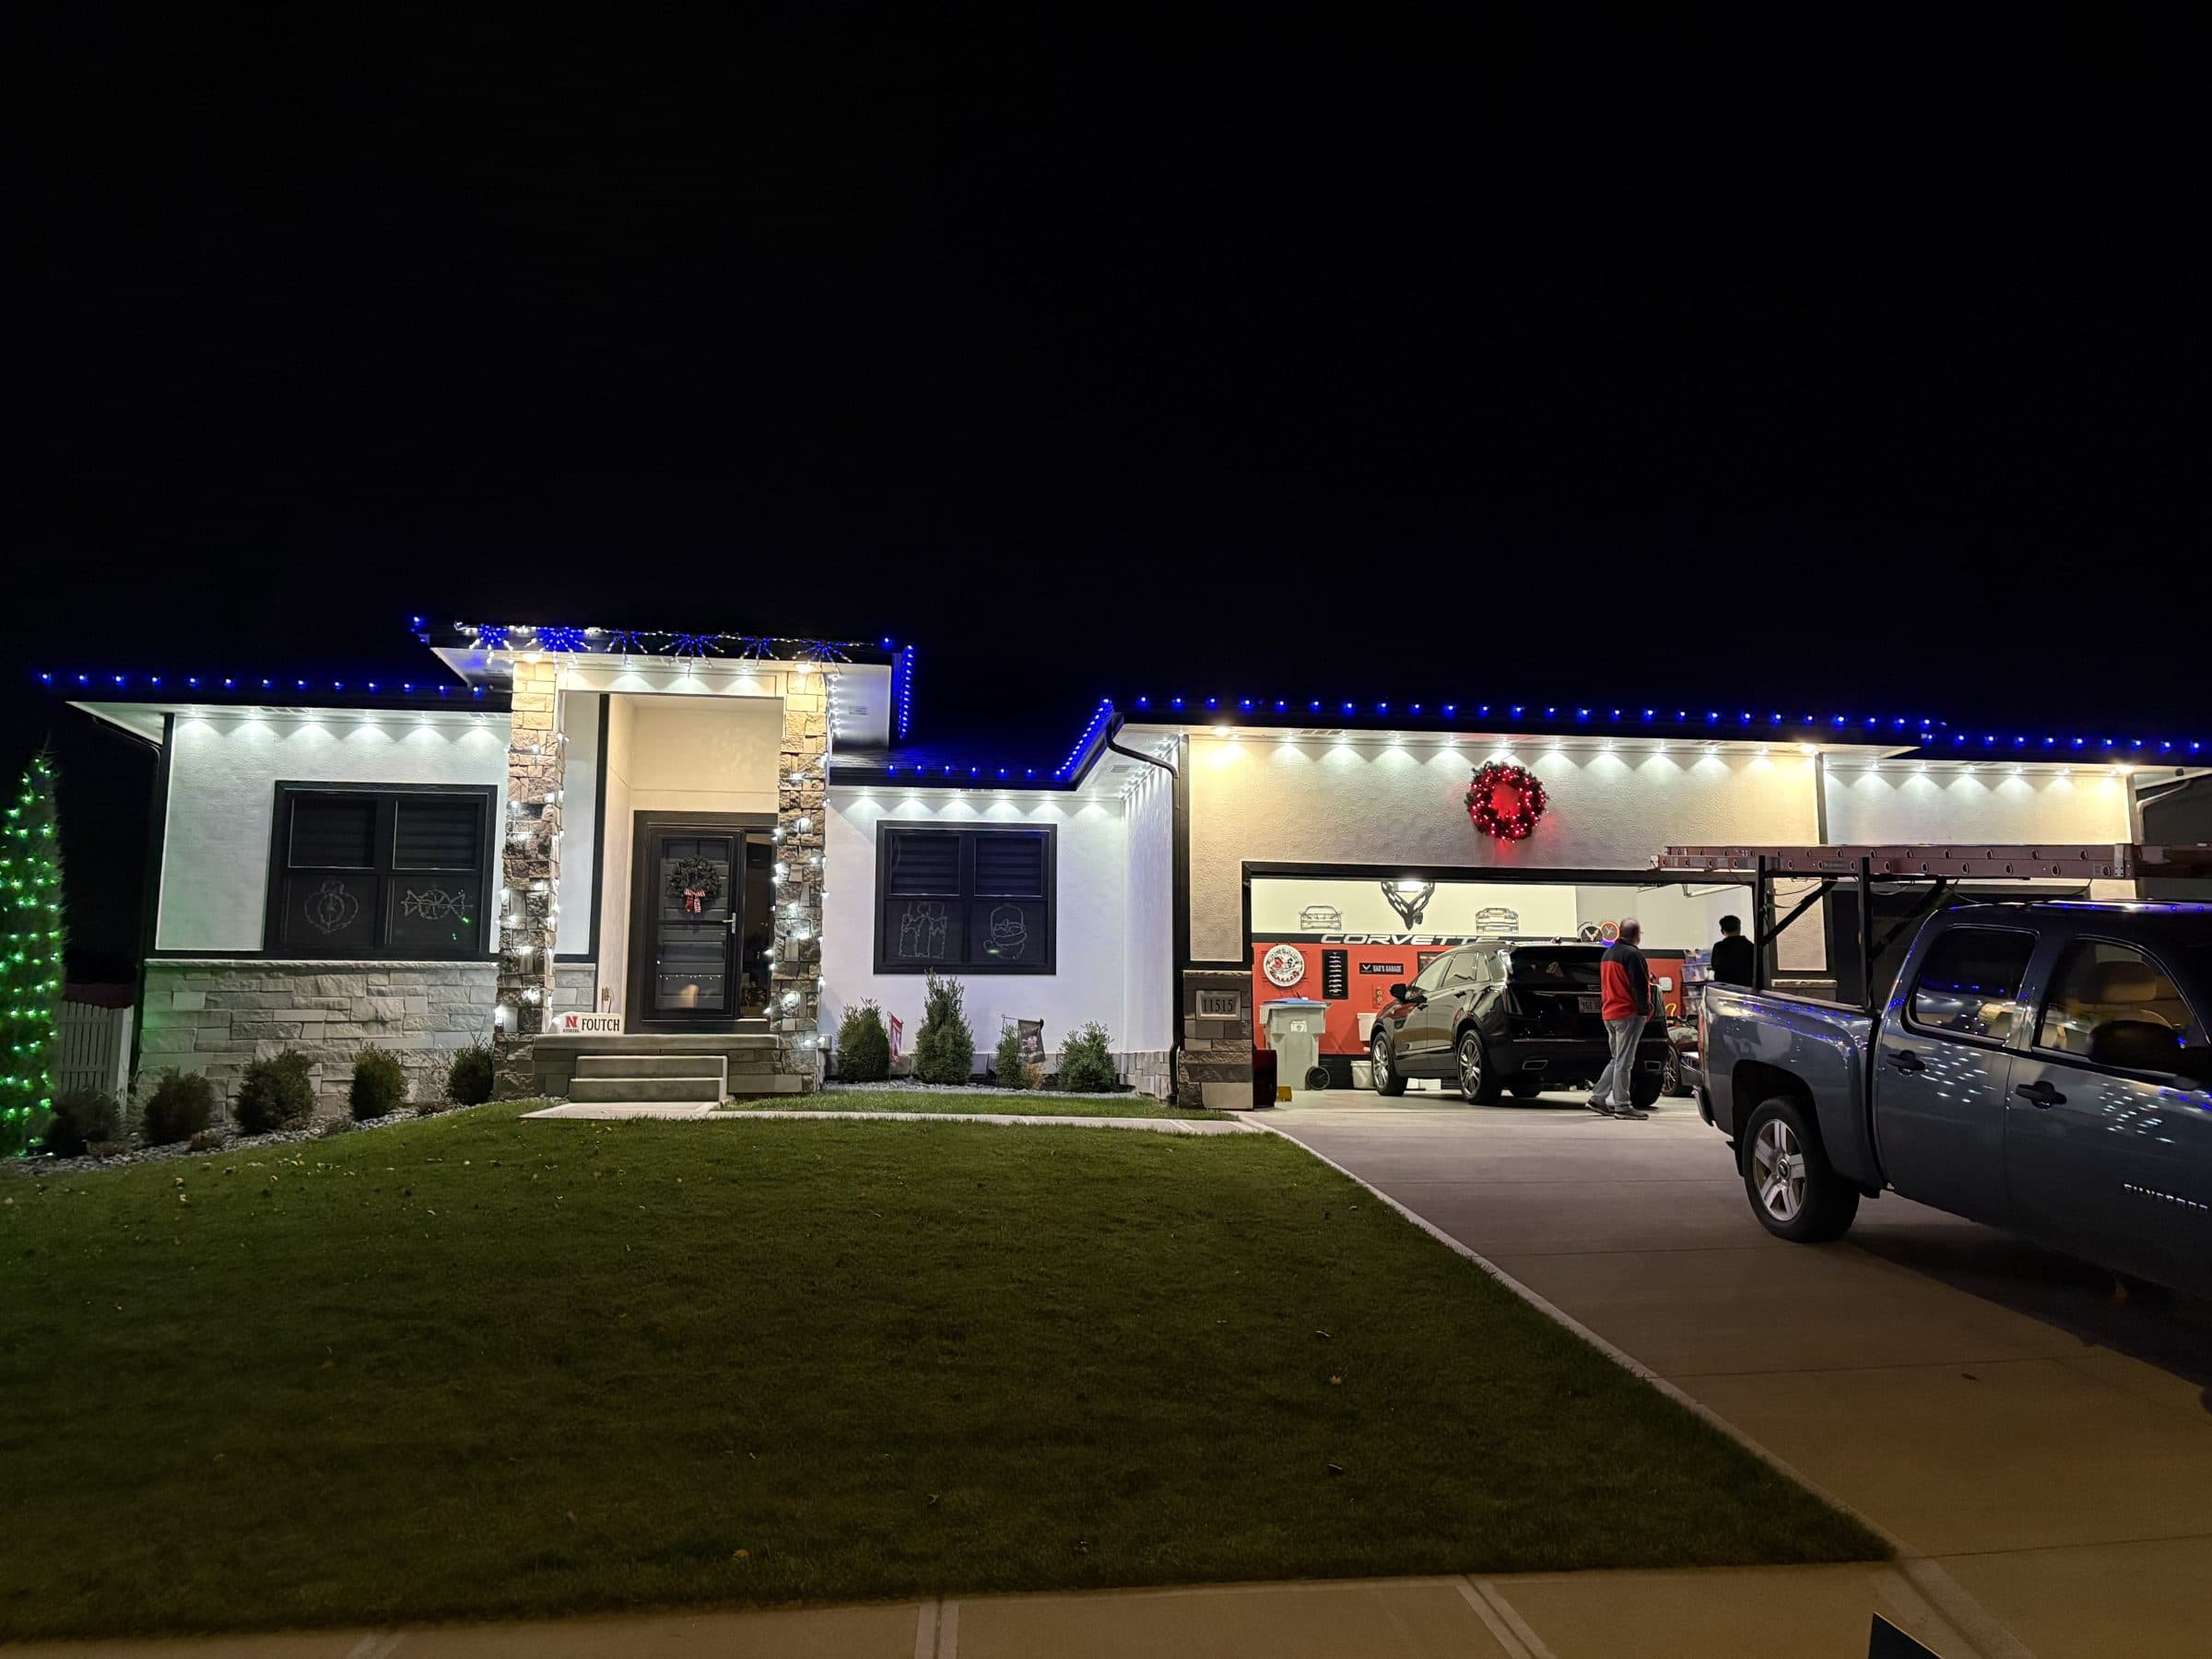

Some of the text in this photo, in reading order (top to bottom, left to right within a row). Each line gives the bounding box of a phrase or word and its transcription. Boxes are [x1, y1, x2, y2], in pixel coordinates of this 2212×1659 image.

[1321, 934, 1499, 946] CORVETTE
[1204, 998, 1233, 1012] 11515
[565, 1016, 620, 1031] N FOUTCH
